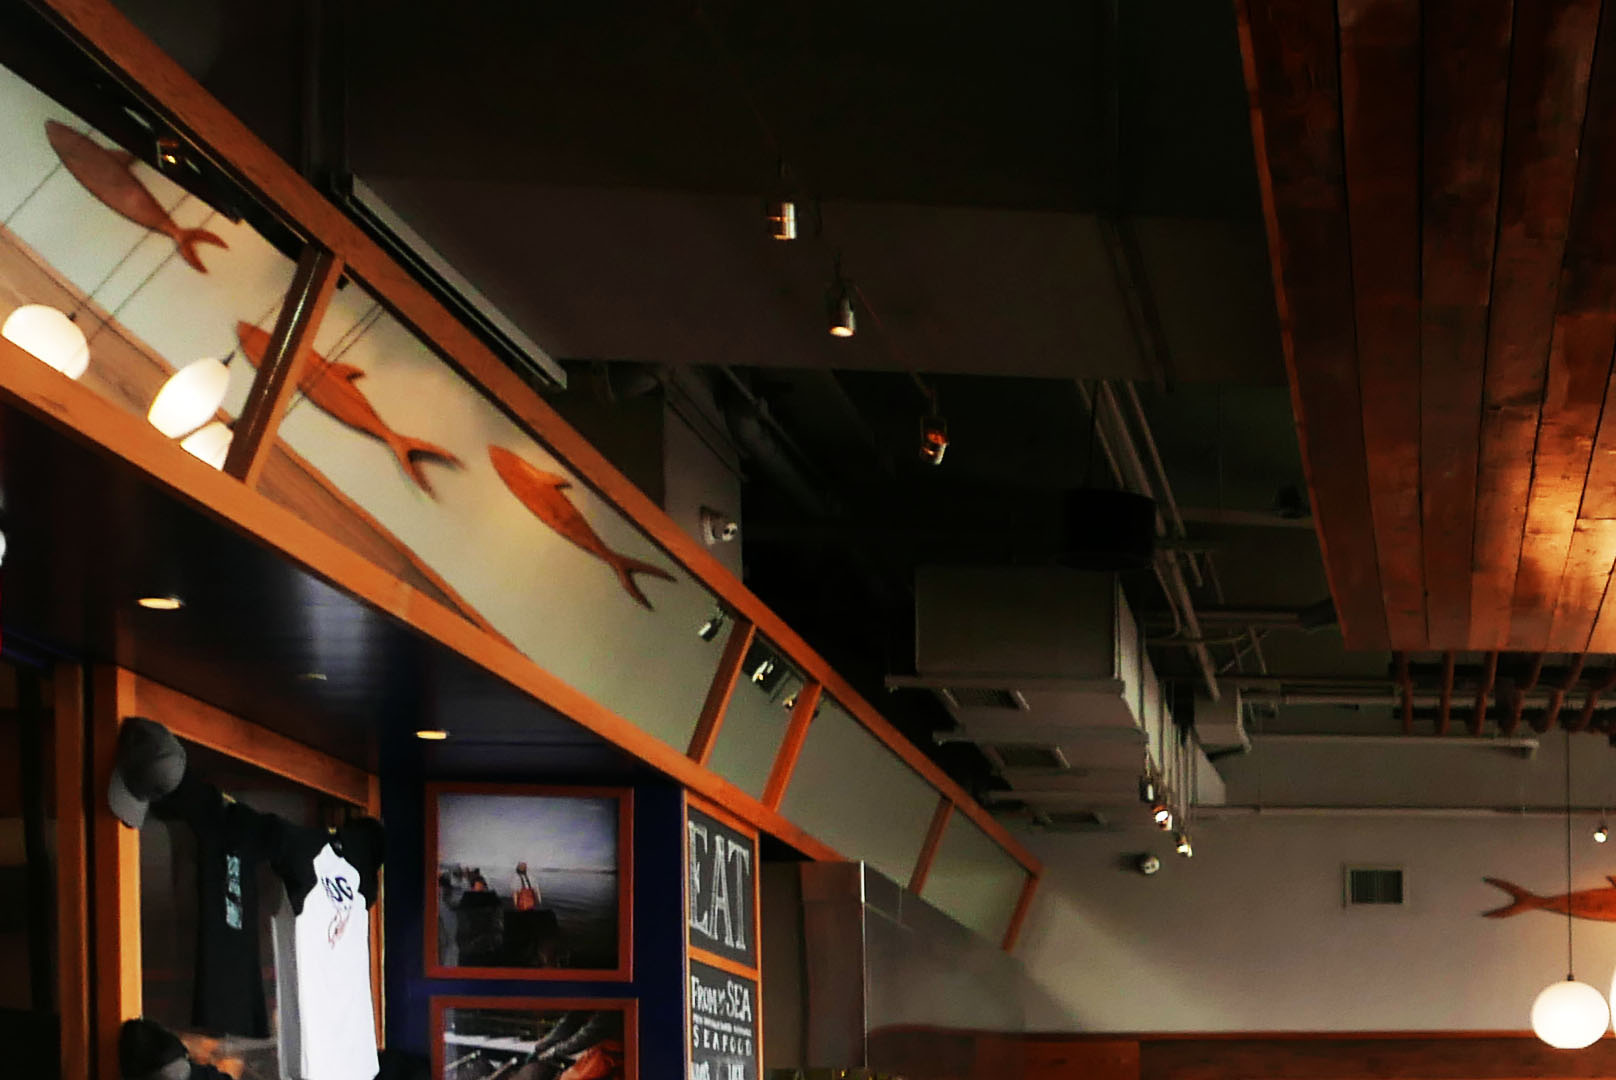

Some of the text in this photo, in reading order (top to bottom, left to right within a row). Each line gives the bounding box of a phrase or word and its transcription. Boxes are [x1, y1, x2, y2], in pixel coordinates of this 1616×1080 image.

[688, 820, 749, 951] EAT
[691, 975, 717, 1015] FROM
[726, 979, 752, 1023] SEA
[693, 1024, 752, 1057] SEAFOOD
